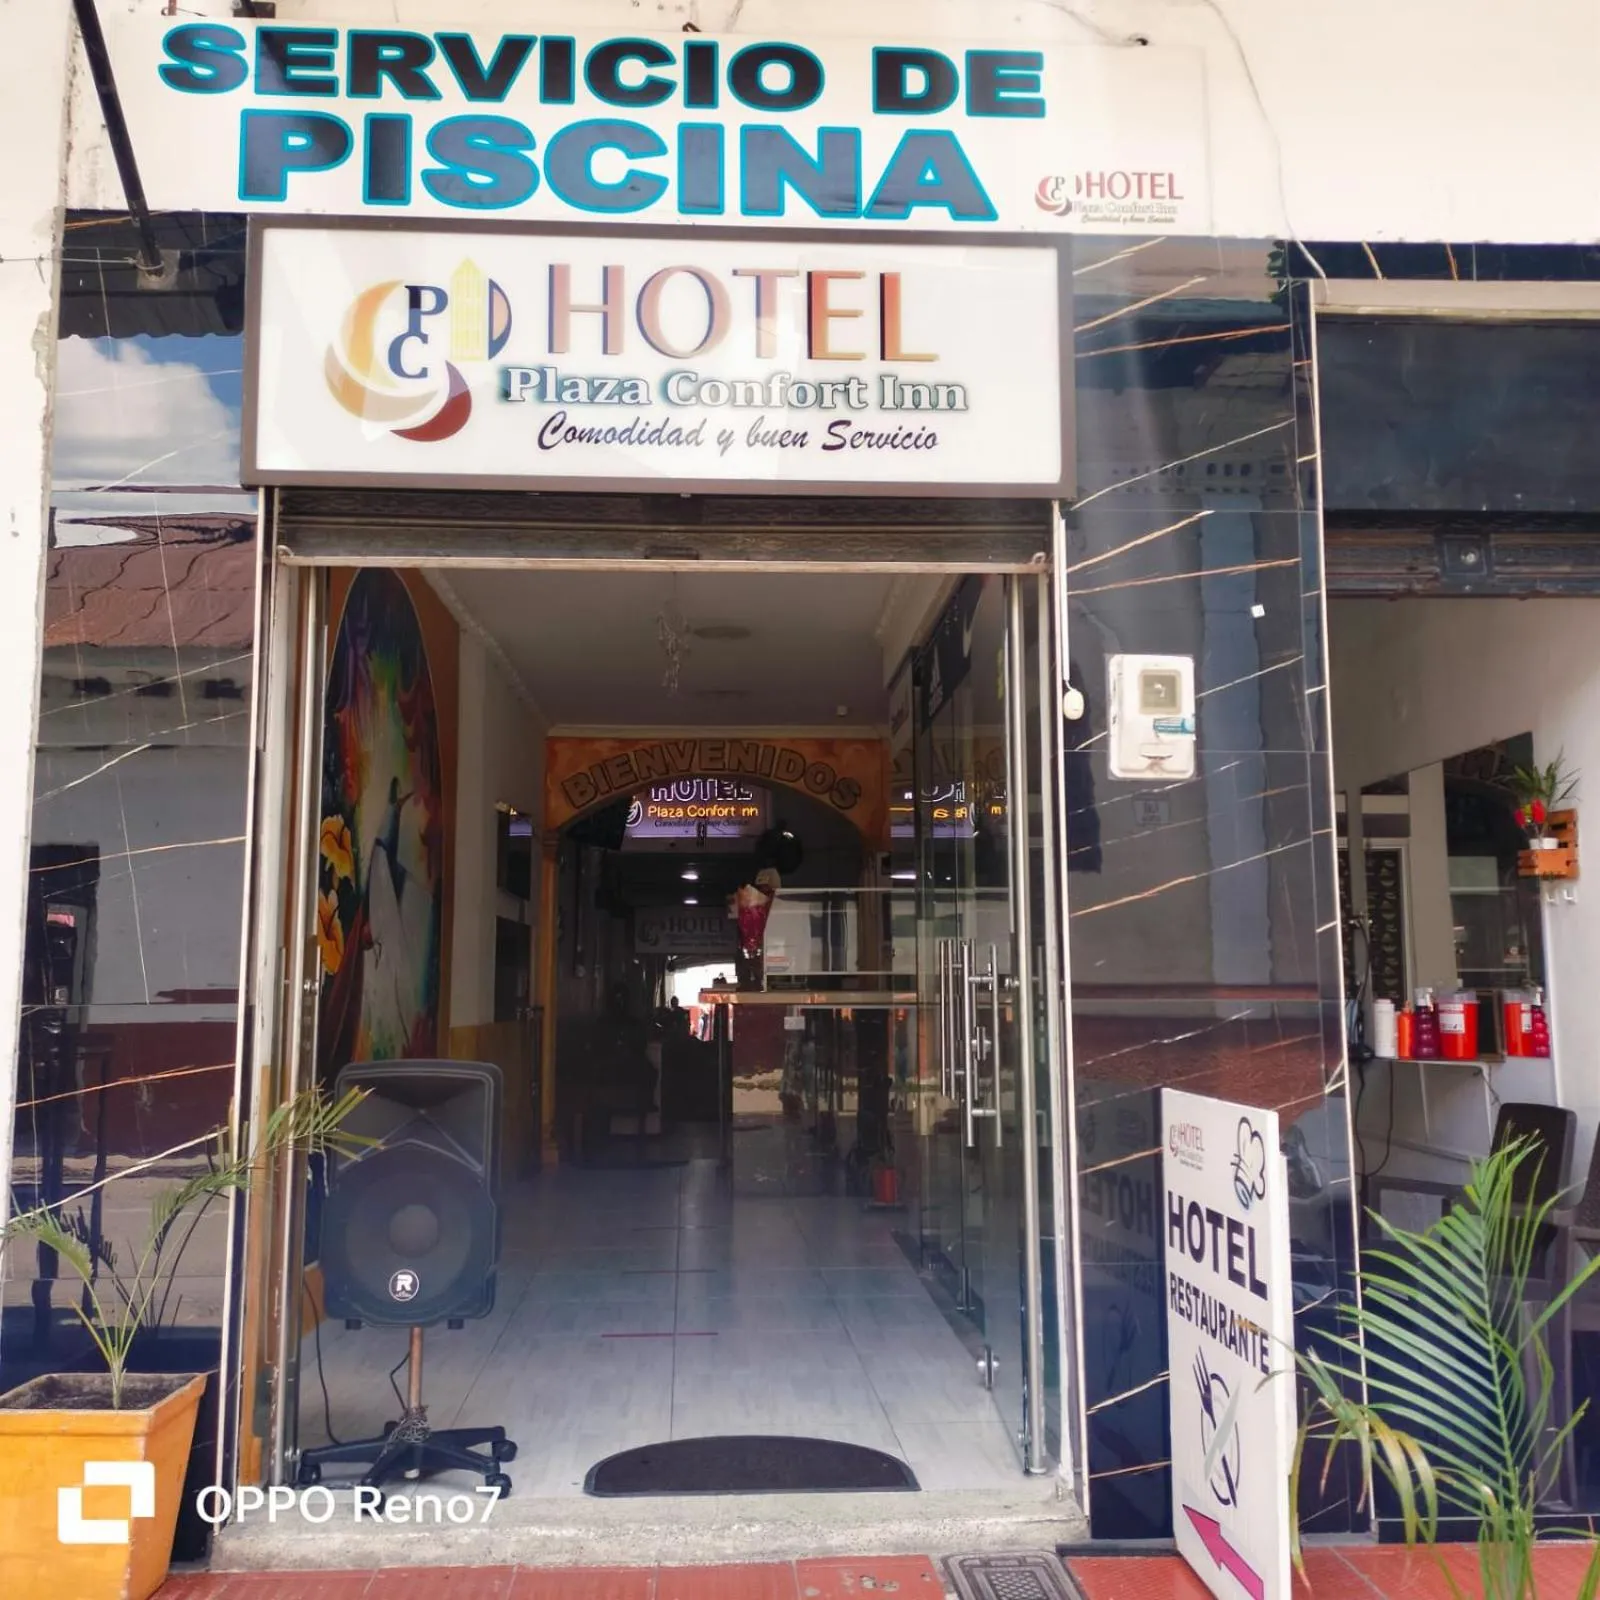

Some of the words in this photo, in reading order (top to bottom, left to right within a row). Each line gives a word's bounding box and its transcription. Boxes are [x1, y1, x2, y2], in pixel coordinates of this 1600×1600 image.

[157, 23, 826, 113] SERVICIO
[872, 46, 1047, 118] DE
[238, 108, 999, 222] PISCINA
[1085, 171, 1185, 200] HOTEL
[547, 263, 940, 362] HOTEL
[506, 367, 651, 406] Plaza
[665, 371, 869, 410] Confort
[880, 374, 969, 411] Inn
[537, 411, 705, 451] Comodidad
[716, 427, 736, 456] y
[746, 415, 810, 449] buen
[821, 419, 940, 451] Servicio
[561, 739, 862, 809] BIENVENIDOS
[647, 805, 684, 818] Plaza
[687, 804, 735, 817] Confort
[1168, 1190, 1268, 1301] HOTEL
[1169, 1271, 1270, 1376] RESTAURANTE
